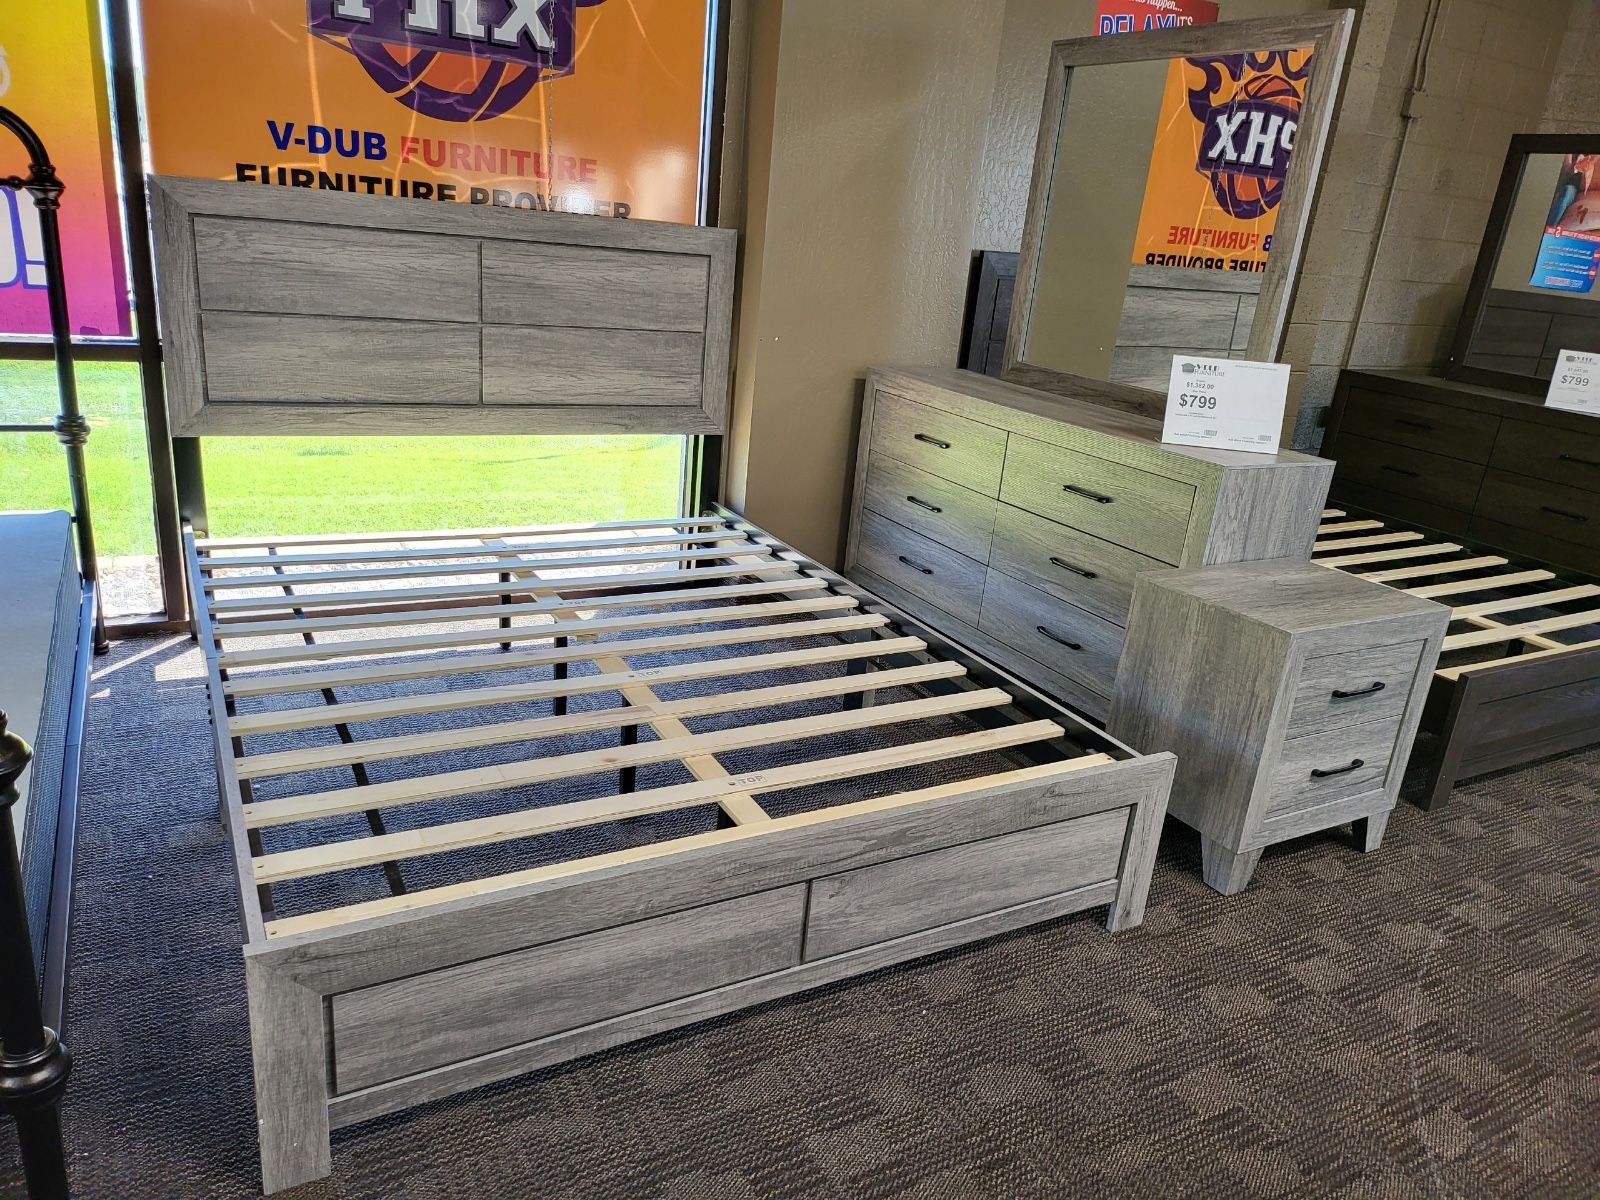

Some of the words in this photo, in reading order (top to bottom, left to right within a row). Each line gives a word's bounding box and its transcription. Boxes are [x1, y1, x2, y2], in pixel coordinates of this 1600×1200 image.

[337, 0, 556, 49] HX
[266, 120, 388, 161] V-DUB
[401, 136, 598, 184] FURNITURE
[236, 162, 457, 202] FURNITURE
[470, 187, 631, 219] PROVIER
[1561, 375, 1589, 386] $799
[1179, 393, 1217, 409] $799
[738, 775, 765, 785] TOP
